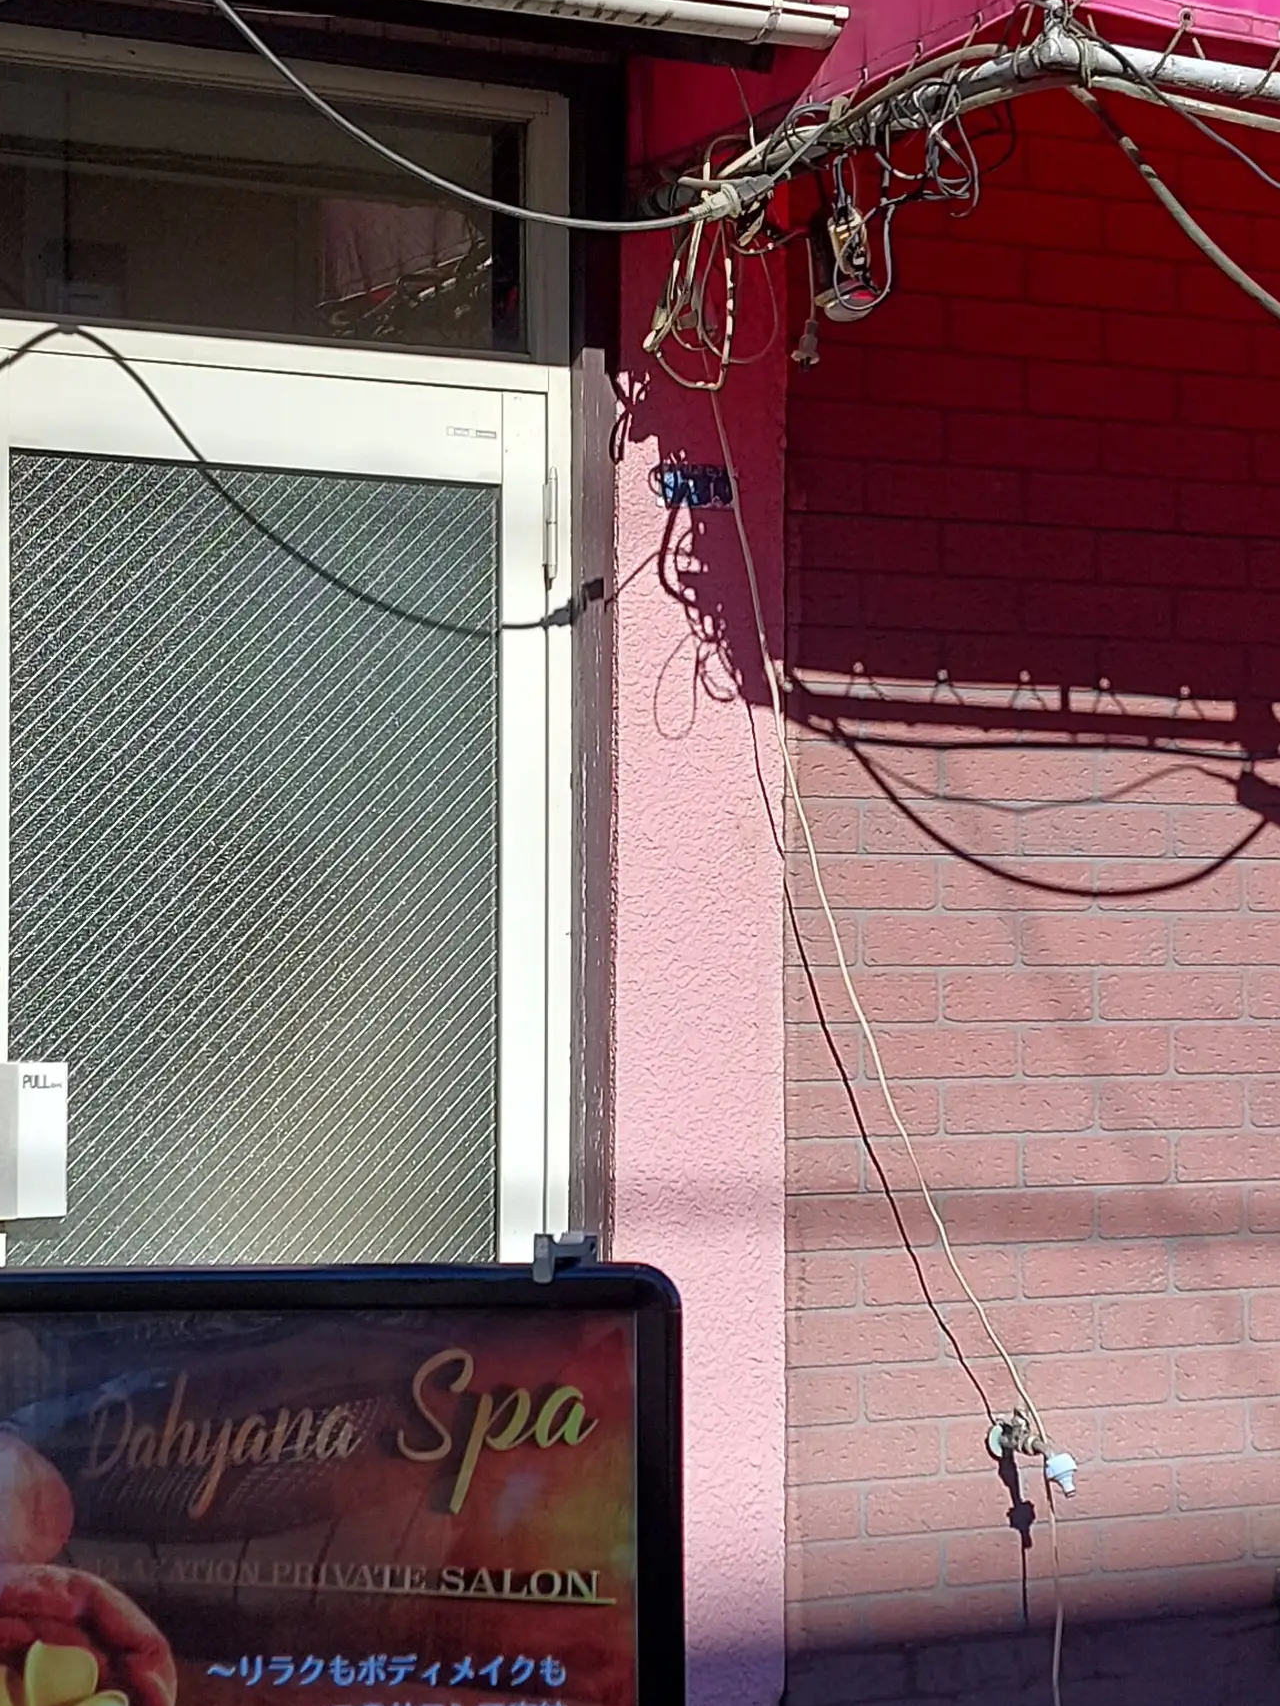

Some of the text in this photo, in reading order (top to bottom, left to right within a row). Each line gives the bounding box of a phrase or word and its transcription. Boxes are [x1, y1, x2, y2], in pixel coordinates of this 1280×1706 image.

[22, 1073, 51, 1089] PULL
[82, 1347, 600, 1519] Dahyana Spa
[272, 1562, 427, 1592] PRIVATE
[439, 1567, 601, 1599] SALON
[206, 1654, 568, 1688] 〜リラクもボディメイクも
